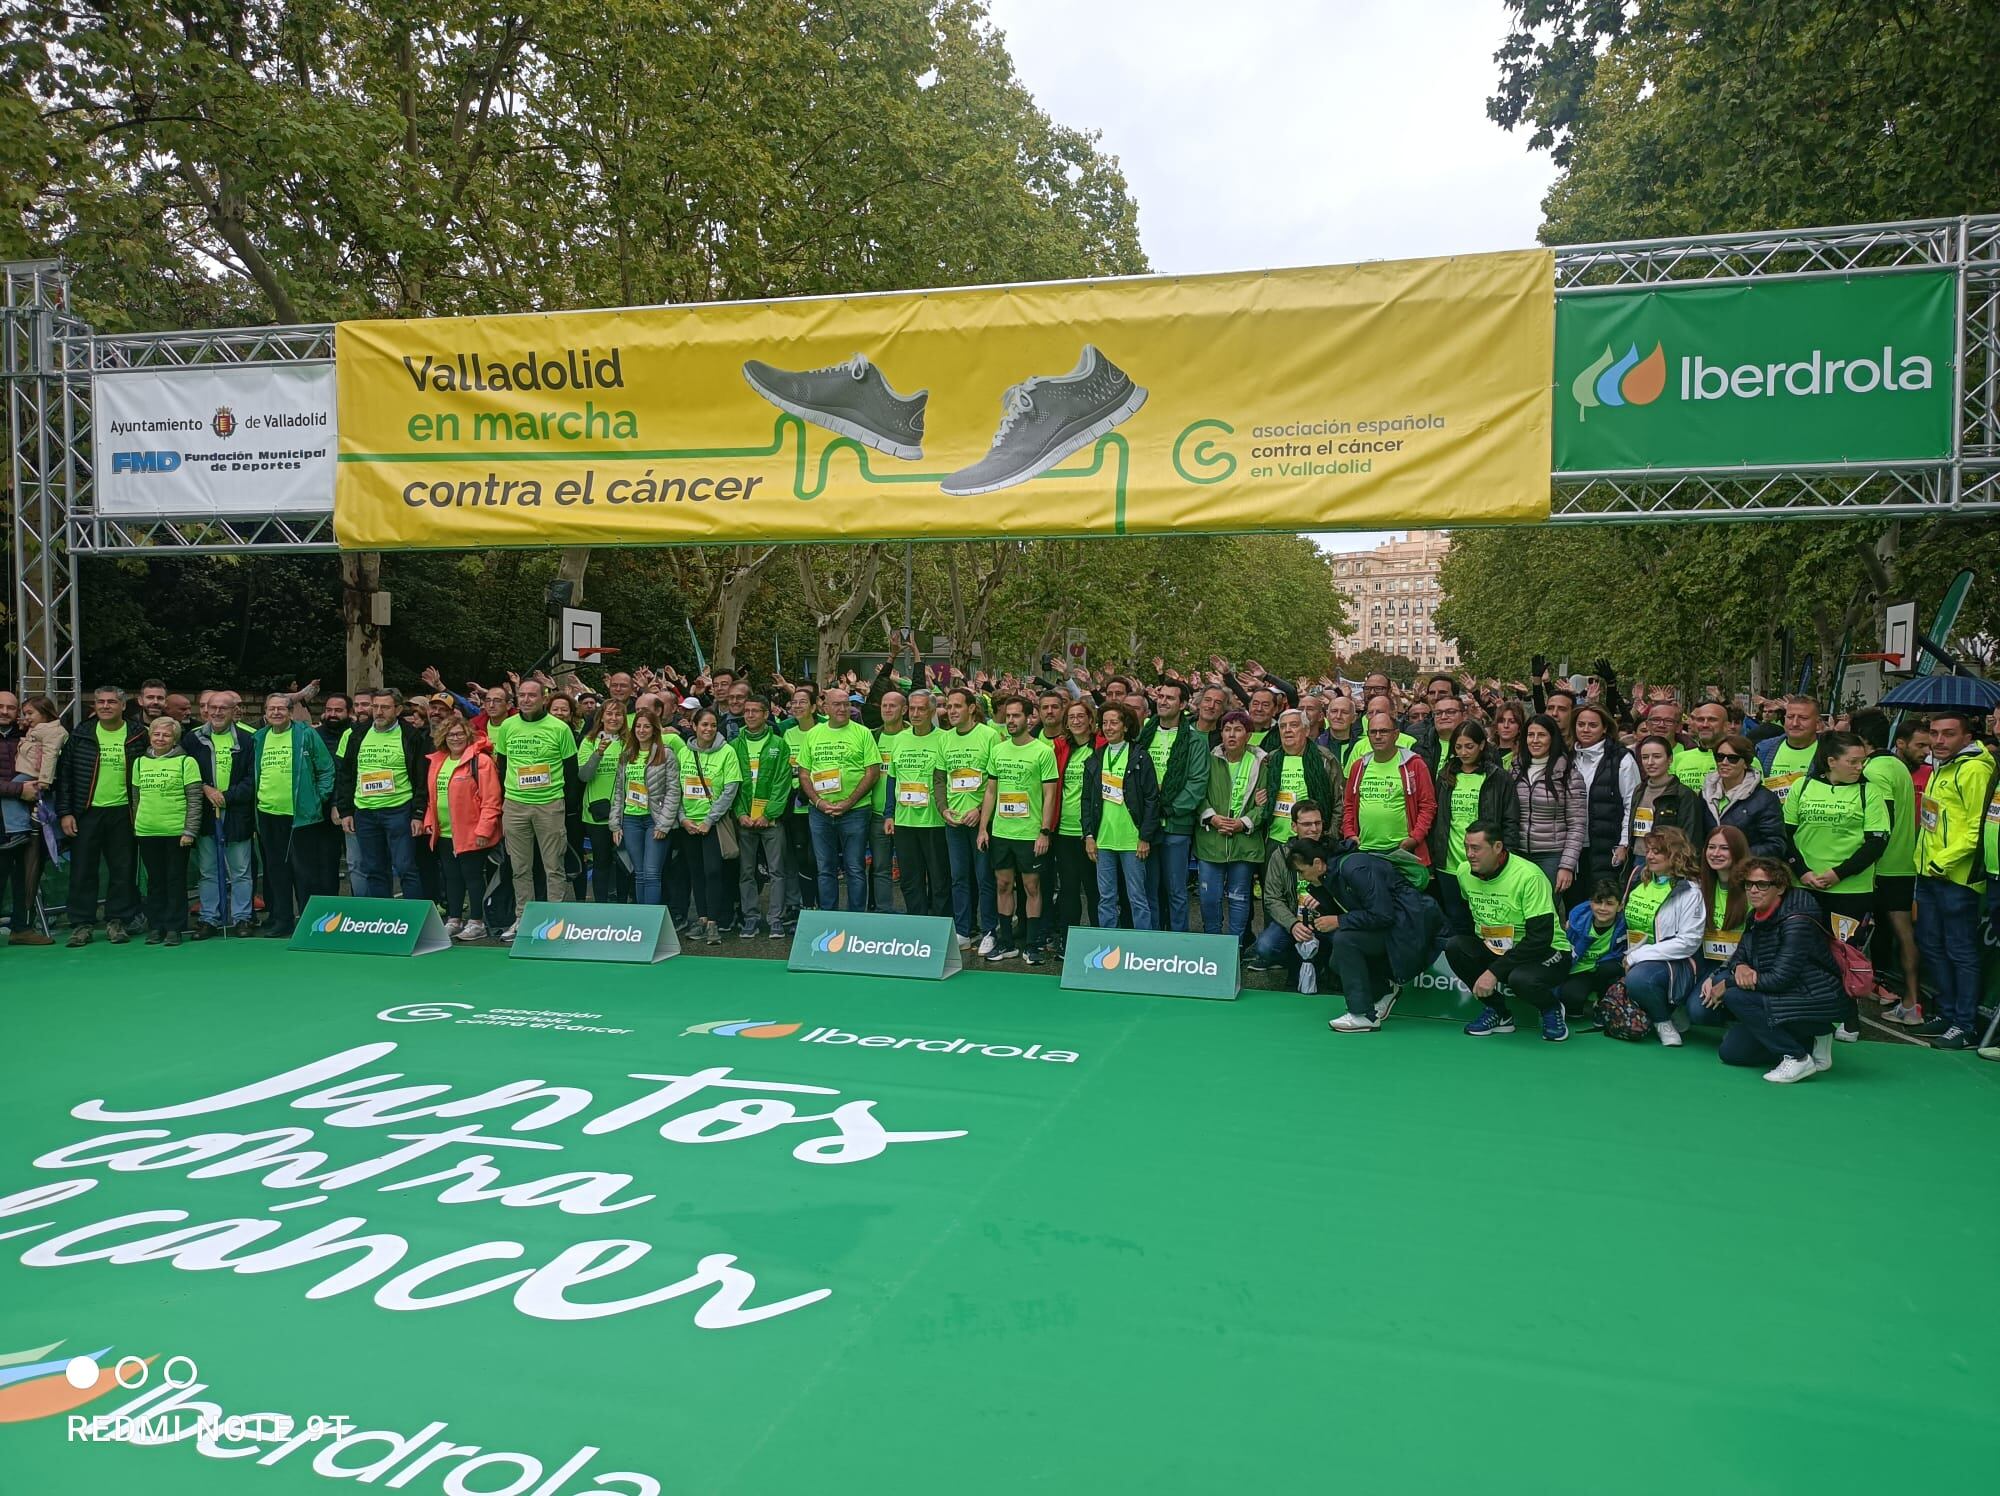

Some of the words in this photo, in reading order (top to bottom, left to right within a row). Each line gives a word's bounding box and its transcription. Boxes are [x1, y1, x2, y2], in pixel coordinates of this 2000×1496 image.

[403, 348, 624, 391] Valladolid
[1681, 346, 1932, 400] Iberdrola
[110, 418, 203, 436] Ayuntamiento
[245, 416, 260, 429] de
[263, 411, 327, 428] Valladolid
[408, 413, 460, 441] en
[474, 401, 638, 440] marcha
[1252, 419, 1351, 438] asociación
[1357, 413, 1445, 436] española
[184, 450, 253, 462] Fundación
[258, 448, 326, 461] Municipal
[1251, 443, 1311, 458] contra
[1316, 440, 1332, 455] el
[1338, 438, 1404, 454] cáncer
[111, 450, 182, 474] FMD
[210, 463, 227, 472] de
[231, 460, 302, 473] Deportes
[1250, 466, 1273, 477] en
[1277, 458, 1371, 477] Valladolid
[403, 473, 542, 508] contra
[554, 470, 595, 506] el
[606, 468, 763, 505] cáncer
[1474, 897, 1499, 905] marcha
[340, 917, 408, 935] Iberdrola
[564, 923, 642, 942] Iberdrola
[847, 936, 931, 958] Iberdrola
[1124, 952, 1217, 976] Iberdrola
[455, 1019, 527, 1028] contra
[472, 1014, 572, 1024] española
[490, 1008, 603, 1019] asociación
[799, 1027, 1079, 1063] Iberdrola
[70, 1041, 969, 1164] Juntos
[33, 1124, 656, 1215] contra
[20, 1195, 832, 1329] cáncer
